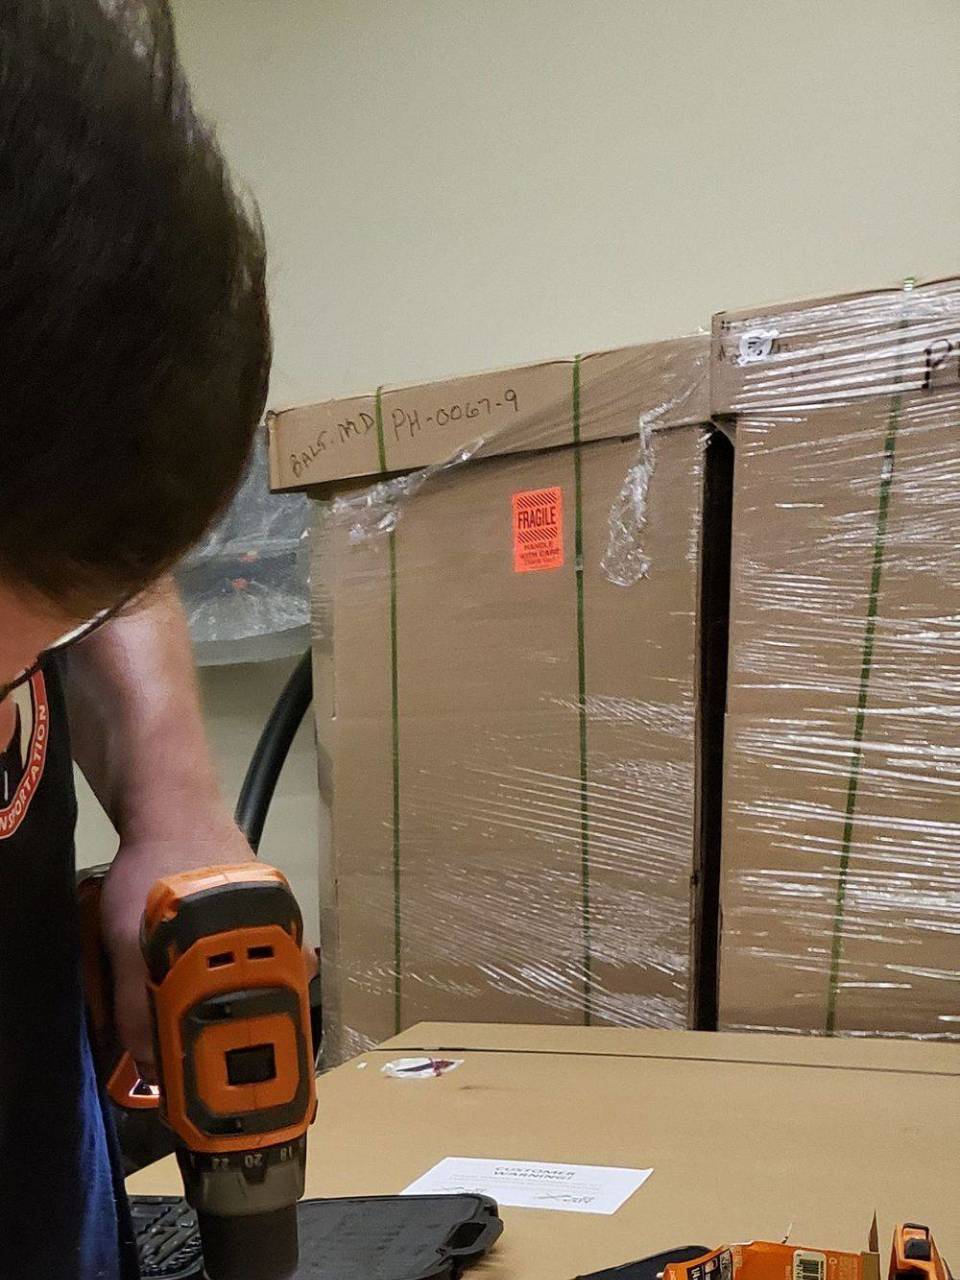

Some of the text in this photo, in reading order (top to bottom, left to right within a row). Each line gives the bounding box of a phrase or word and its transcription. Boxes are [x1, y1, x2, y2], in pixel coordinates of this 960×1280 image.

[392, 389, 519, 441] PH-0067-9
[517, 506, 556, 530] FRAGILE
[493, 1171, 573, 1181] WARNING!
[495, 1166, 576, 1177] CUSTOMER
